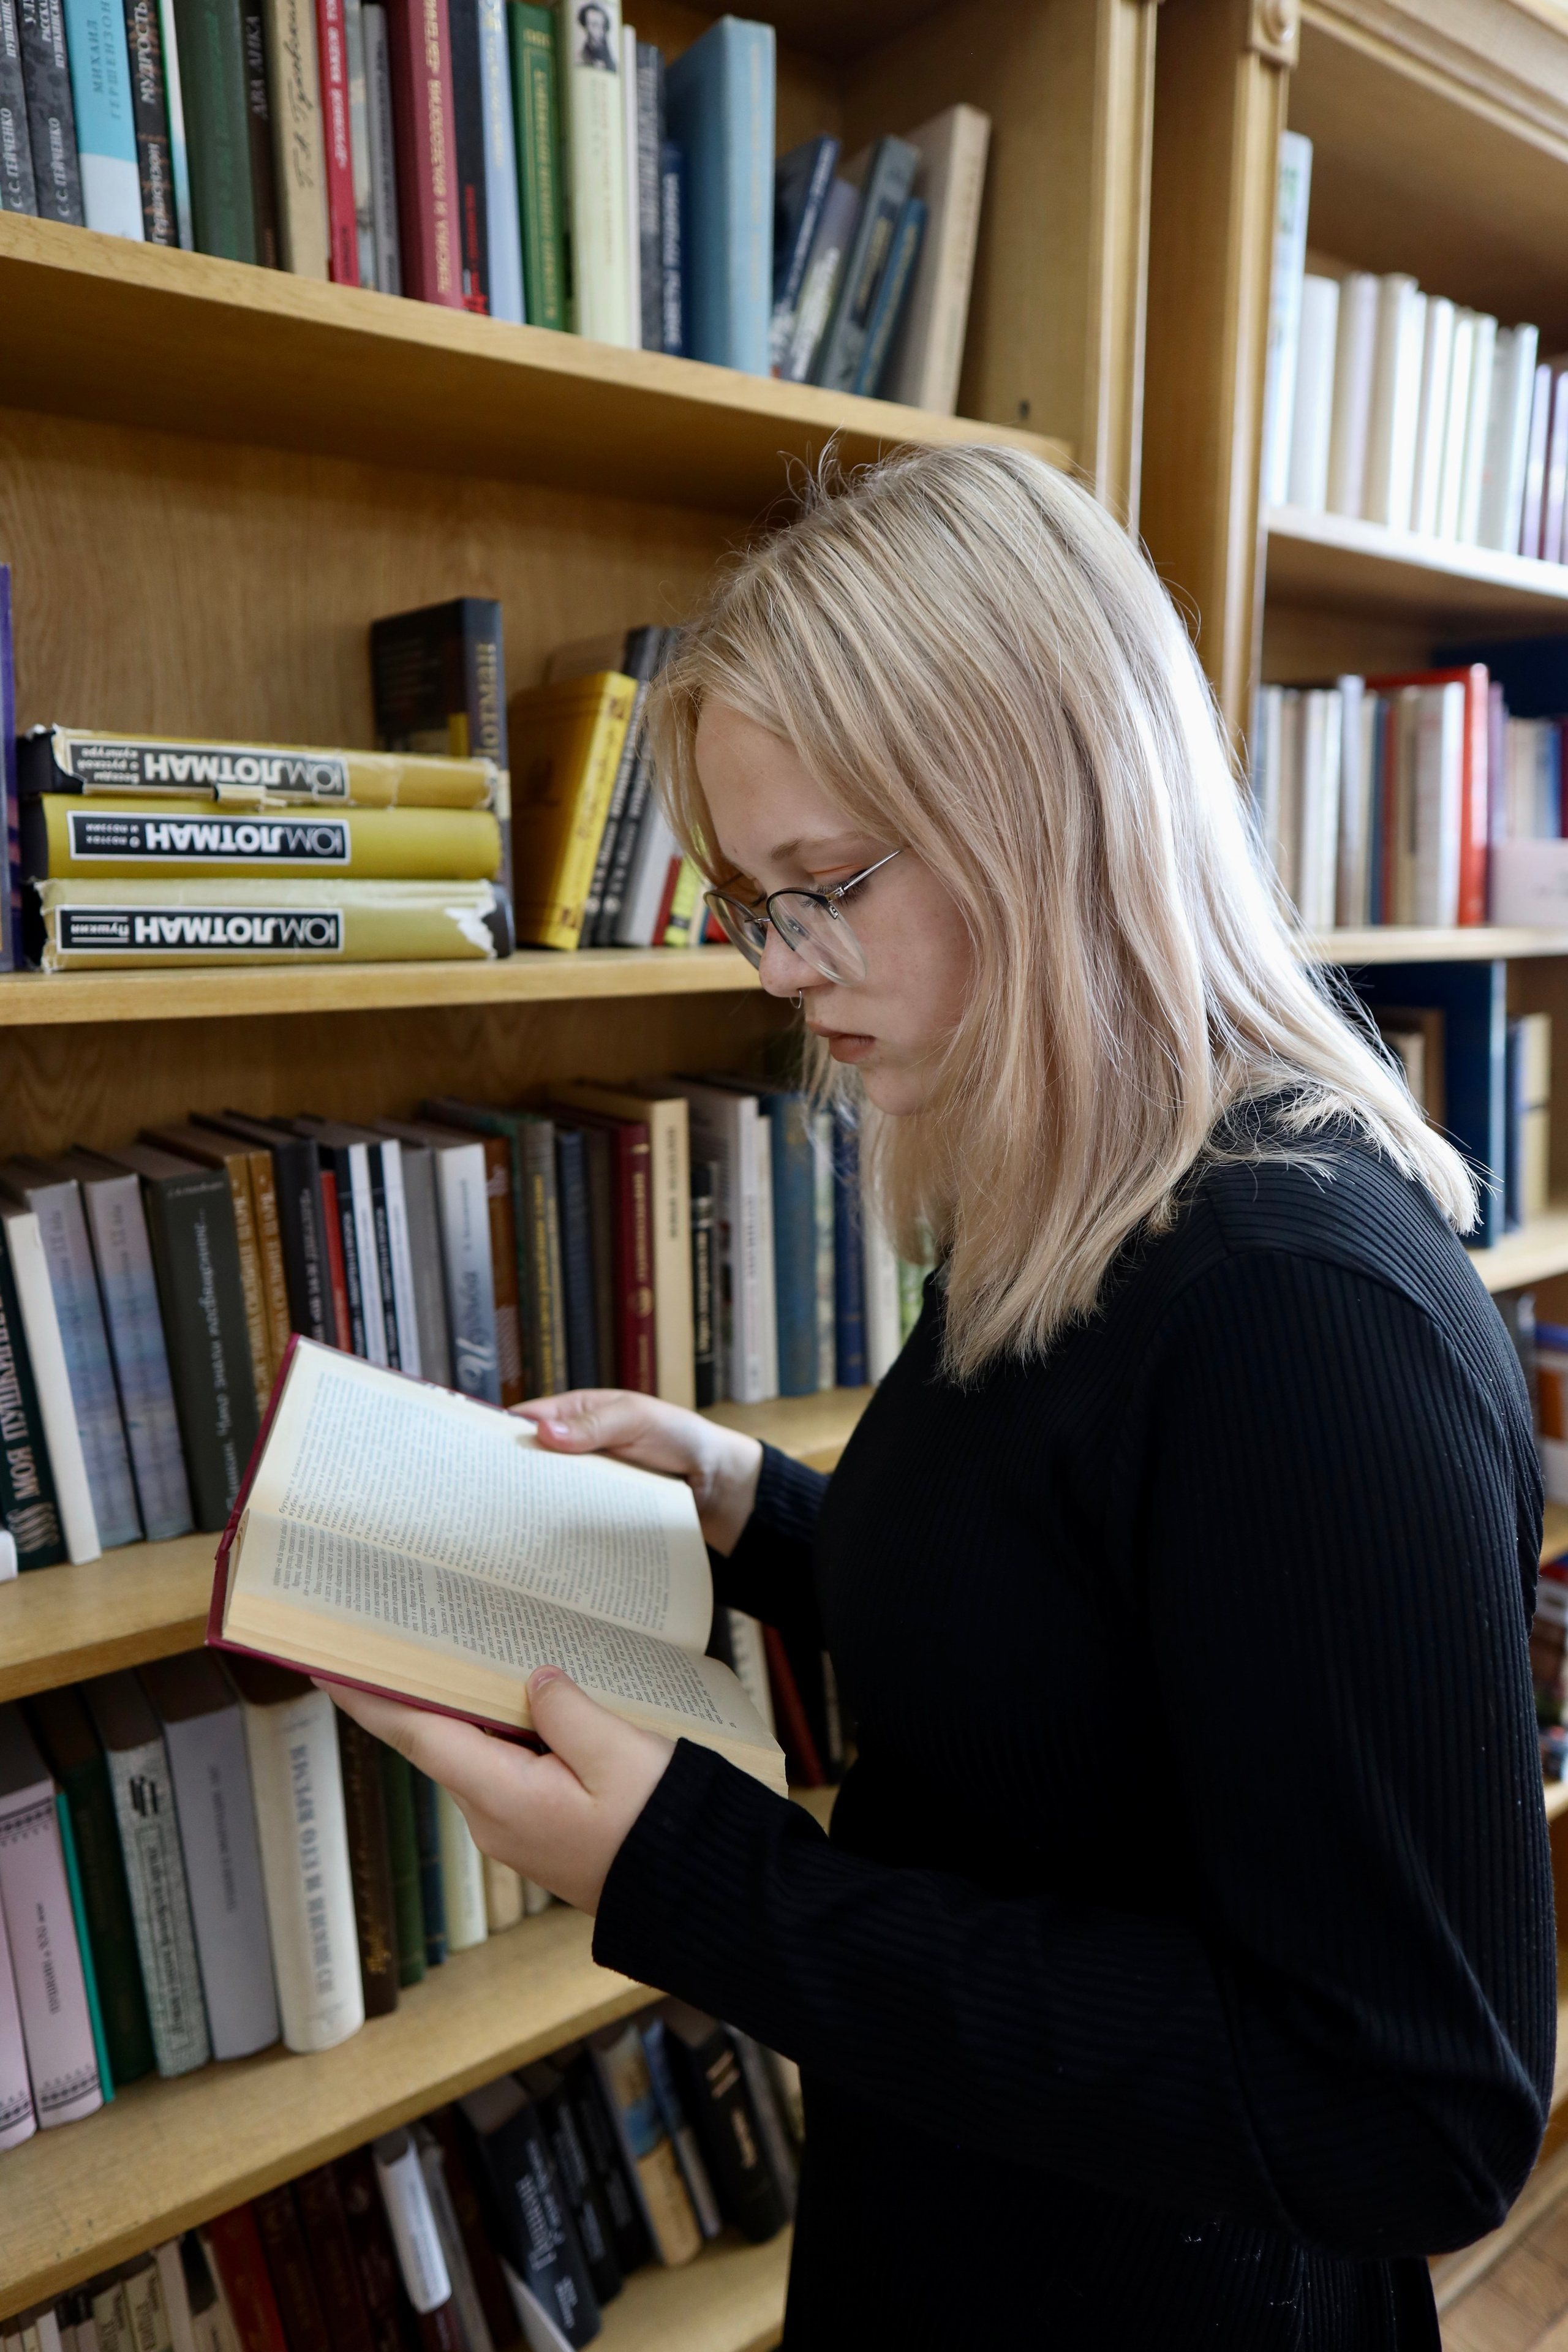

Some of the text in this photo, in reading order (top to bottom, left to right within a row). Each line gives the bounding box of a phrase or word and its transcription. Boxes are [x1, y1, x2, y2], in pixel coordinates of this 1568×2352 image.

[86, 19, 104, 95] МИХАИЛ
[134, 2, 156, 104] МУДРОСТЬ
[70, 923, 130, 938] Пушкин
[6, 1446, 41, 1500] МОЯ
